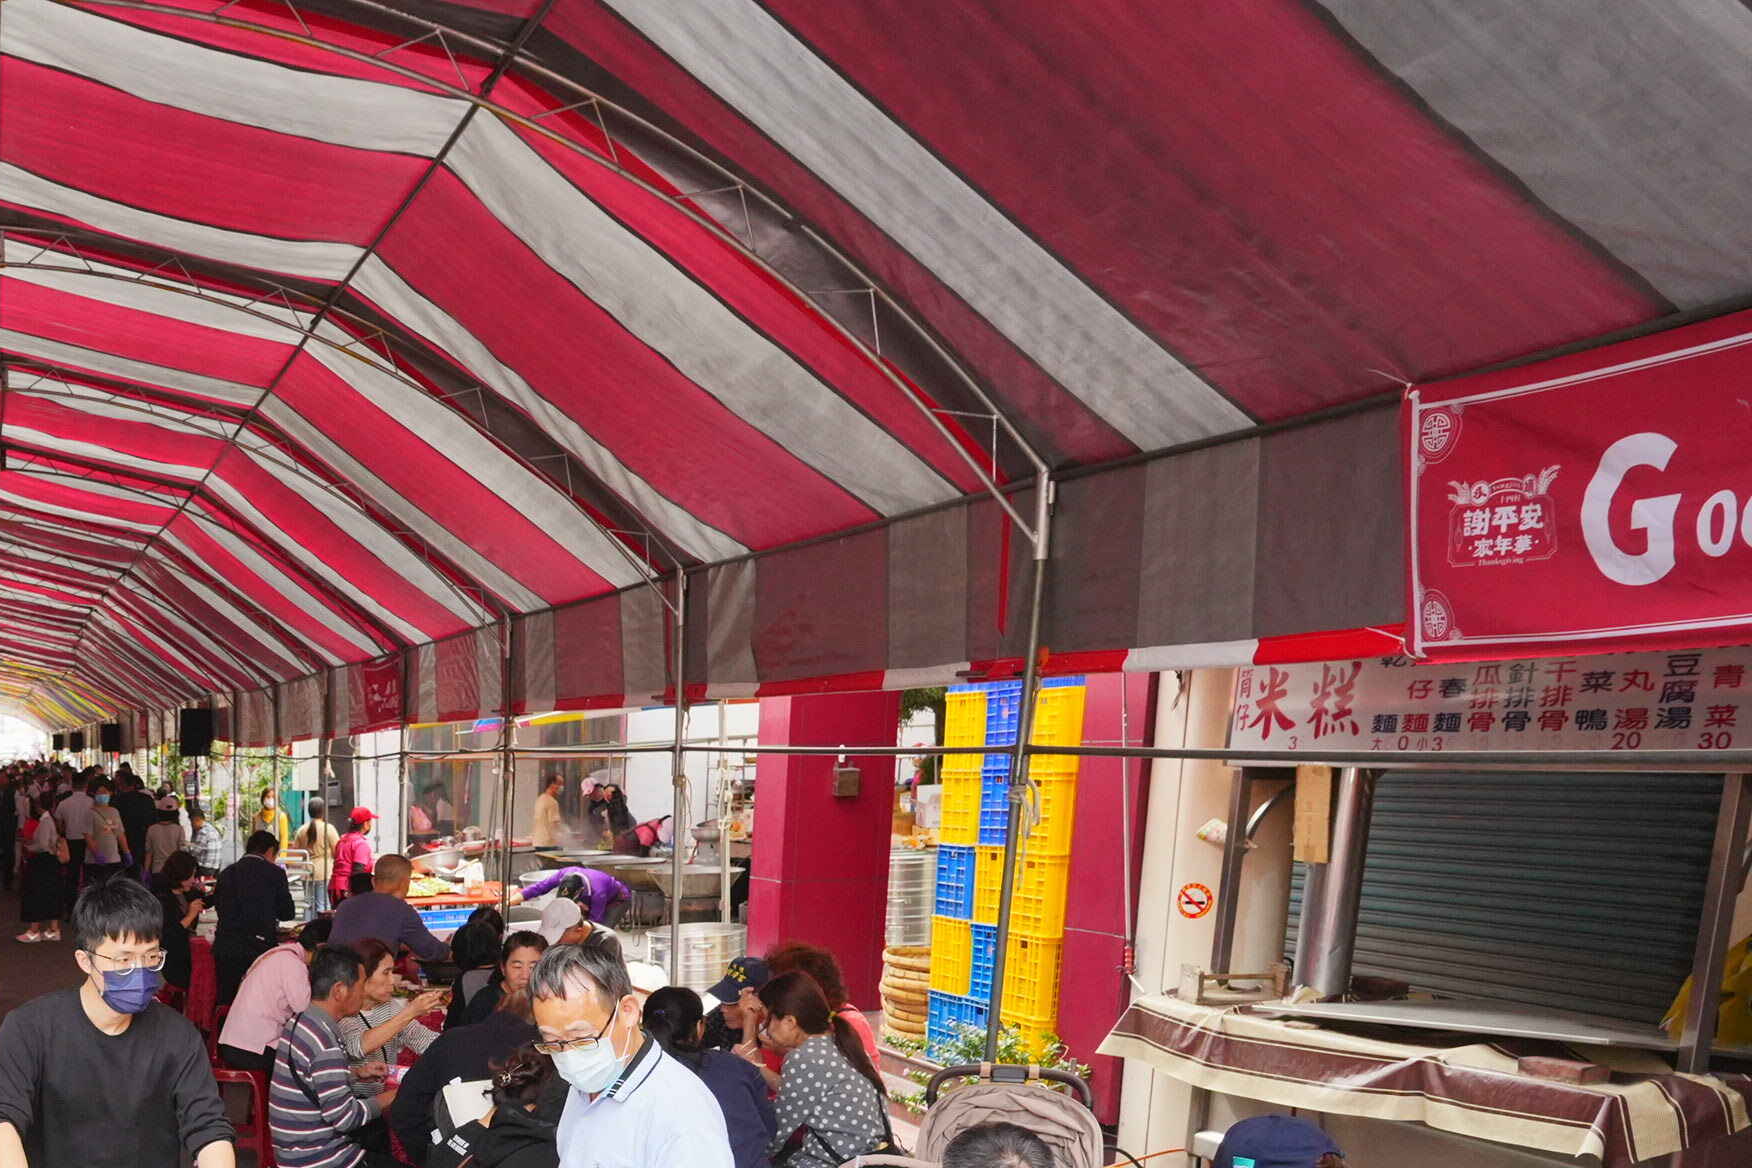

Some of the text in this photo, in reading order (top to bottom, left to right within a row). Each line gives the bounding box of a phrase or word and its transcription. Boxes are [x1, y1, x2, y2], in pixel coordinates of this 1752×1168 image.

[1463, 502, 1544, 537] 謝平安
[1580, 431, 1752, 587] Go
[1472, 534, 1533, 558] 家年華
[1249, 661, 1362, 740] 米糕
[1611, 732, 1642, 750] 20
[1698, 731, 1733, 750] 30
